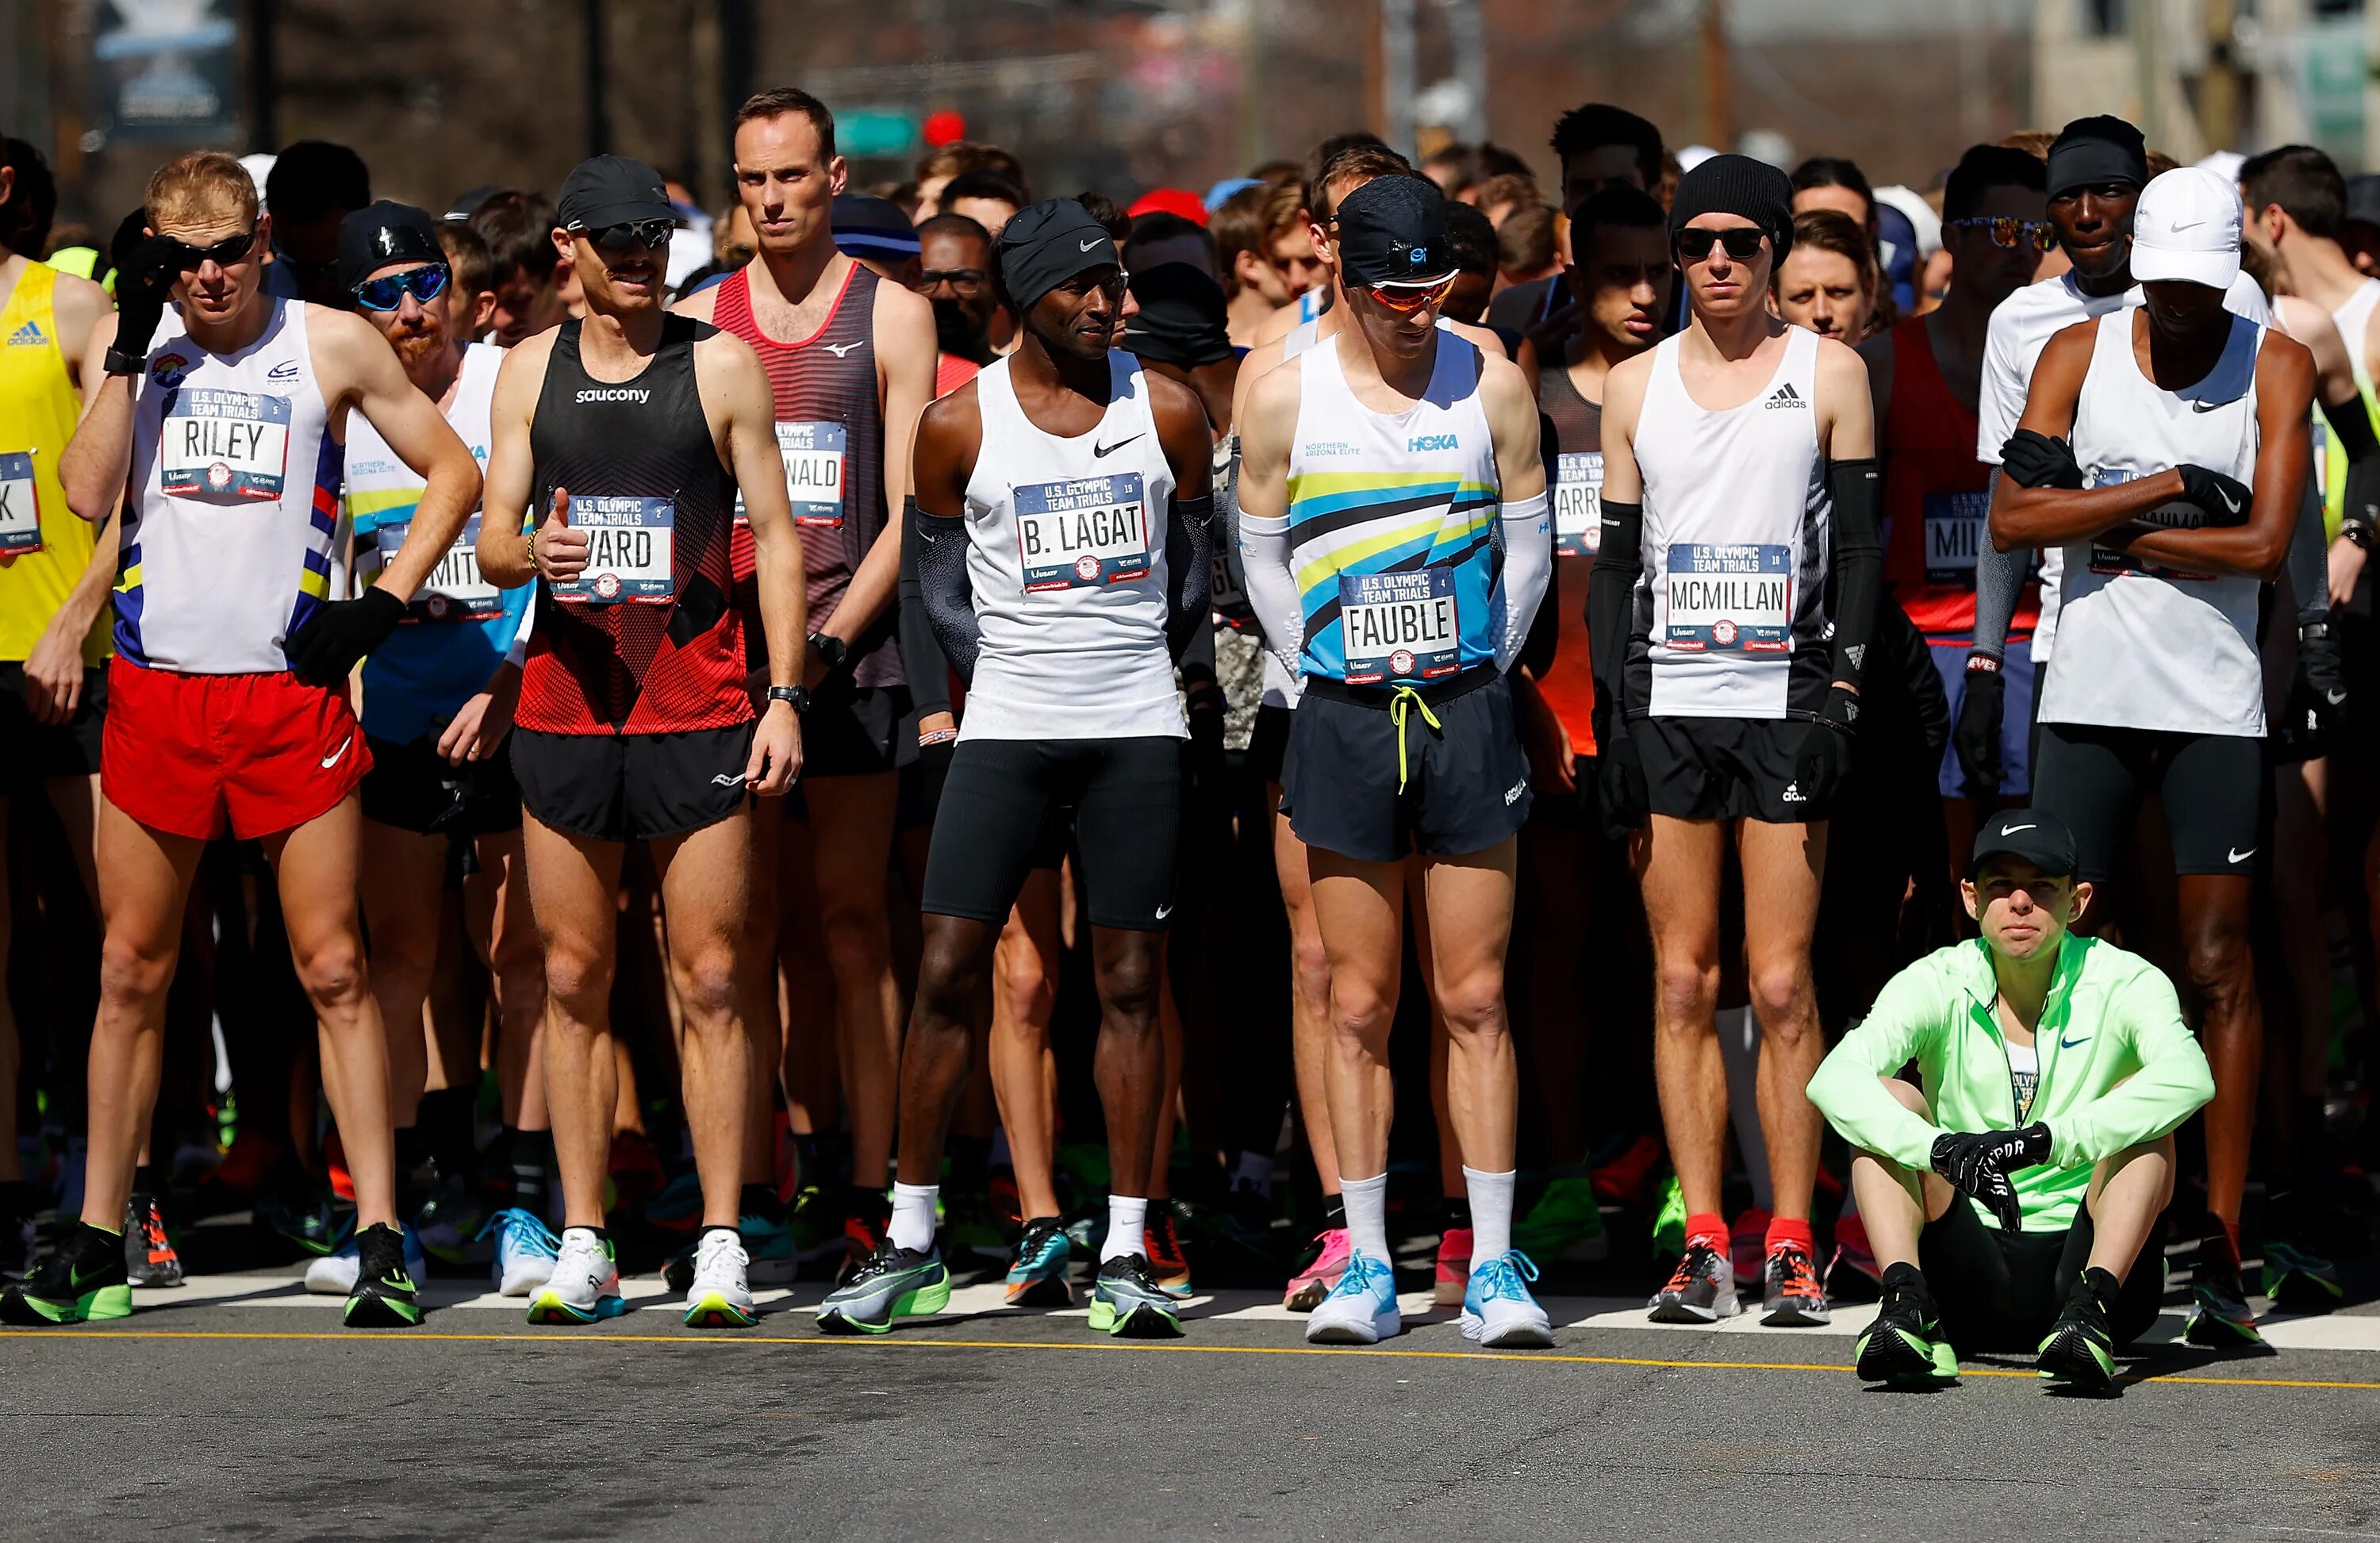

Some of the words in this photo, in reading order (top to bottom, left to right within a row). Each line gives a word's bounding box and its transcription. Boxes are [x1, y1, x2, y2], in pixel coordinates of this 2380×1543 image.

[191, 390, 211, 403] U.S.
[213, 392, 259, 407] OLYMPIC
[575, 389, 651, 405] saucony
[1765, 399, 1806, 409] adidas
[191, 404, 219, 416] TEAM
[221, 406, 259, 420] TRIALS
[272, 405, 278, 415] 5
[185, 420, 264, 461] RILEY
[778, 437, 815, 450] TRIALS
[1306, 442, 1348, 451] NORTHERN
[1407, 434, 1459, 452] HOKA
[1559, 457, 1578, 470] U.S.
[1559, 470, 1586, 482] TEAM
[1045, 486, 1065, 498] U.S.
[1066, 478, 1111, 495] OLYMPIC
[1124, 484, 1133, 494] 19
[577, 500, 596, 512] U.S.
[597, 500, 642, 513] OLYMPIC
[1046, 497, 1074, 511] TEAM
[1077, 492, 1113, 508] TRIALS
[1559, 487, 1602, 516] ARR
[577, 512, 604, 525] TEAM
[606, 513, 642, 526] TRIALS
[656, 509, 662, 518] 2
[1023, 520, 1050, 555] B.
[1059, 506, 1138, 551] LAGAT
[1693, 547, 1712, 558] U.S.
[1715, 547, 1760, 559] OLYMPIC
[1694, 560, 1720, 572] TEAM
[1723, 560, 1760, 572] TRIALS
[1362, 578, 1382, 589] U.S.
[1384, 574, 1429, 588] OLYMPIC
[1441, 579, 1445, 588] 4
[1363, 590, 1391, 603] TEAM
[1393, 587, 1430, 601] TRIALS
[1672, 582, 1783, 611] MCMILLAN
[1349, 601, 1449, 647] FAUBLE
[1855, 643, 1866, 670] adidas
